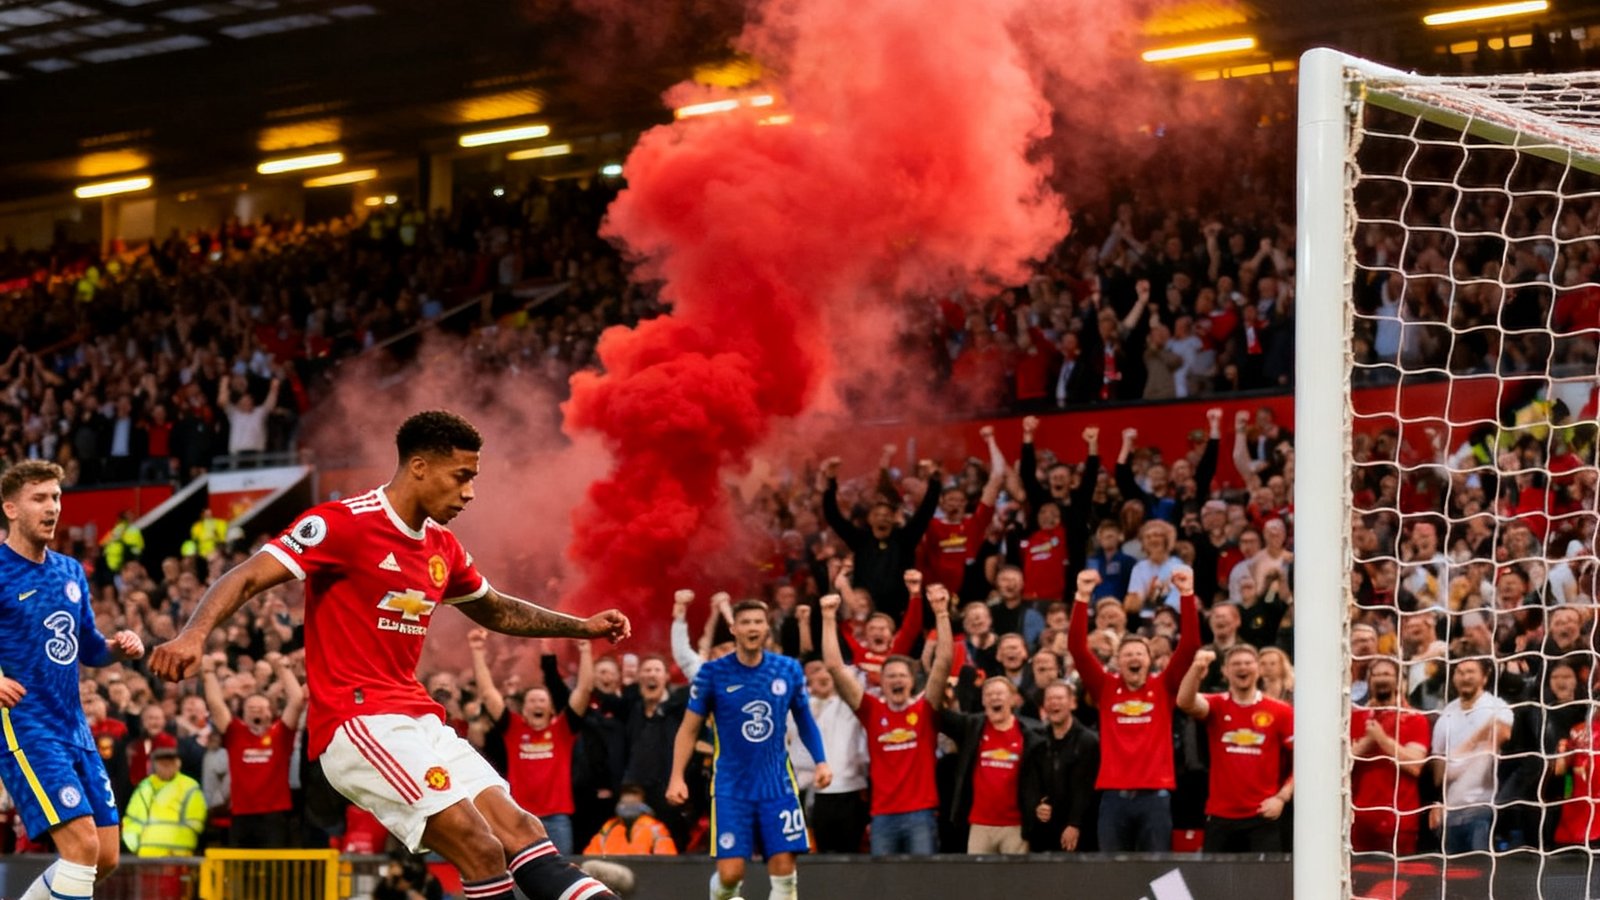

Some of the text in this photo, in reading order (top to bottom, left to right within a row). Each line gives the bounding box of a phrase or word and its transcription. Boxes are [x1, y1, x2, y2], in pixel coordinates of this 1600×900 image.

[44, 611, 79, 665] 3
[741, 700, 774, 743] 3
[779, 809, 805, 835] 20
